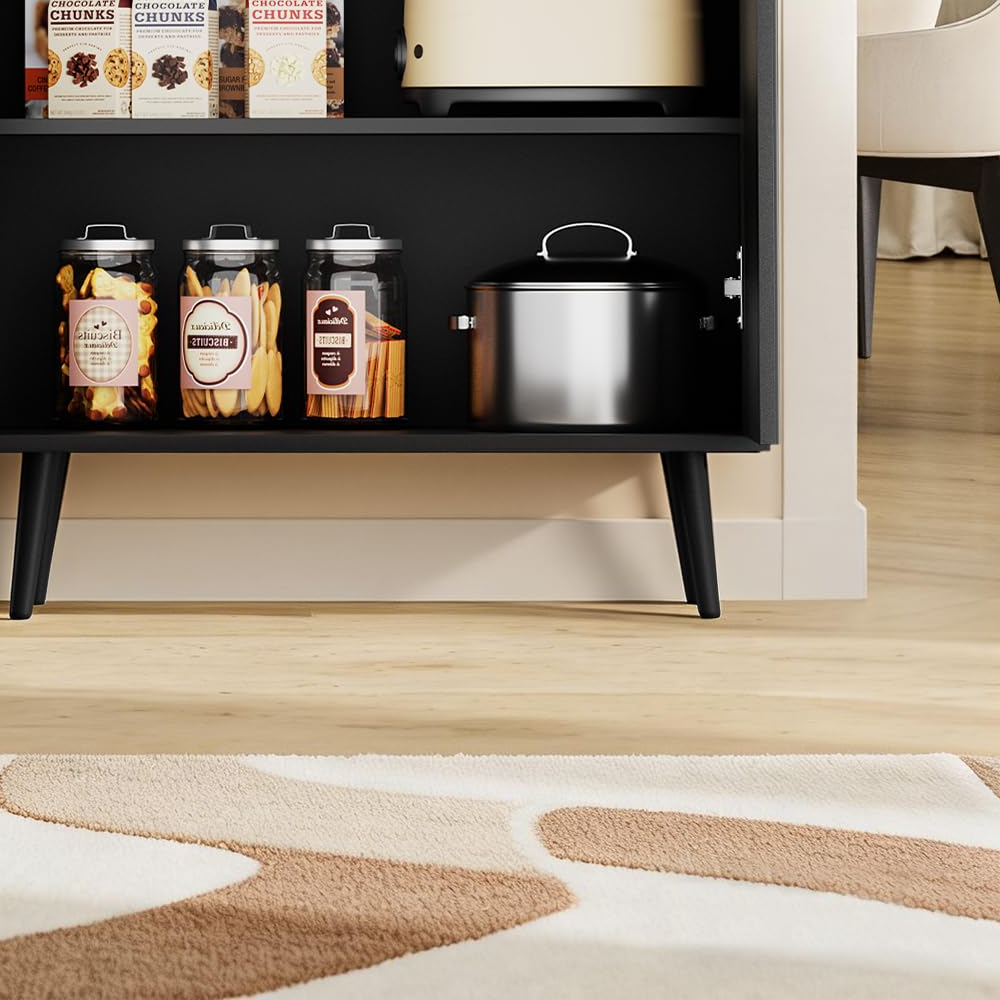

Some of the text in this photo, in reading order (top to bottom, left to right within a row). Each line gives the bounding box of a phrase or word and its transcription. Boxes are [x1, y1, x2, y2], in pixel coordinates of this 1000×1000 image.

[51, 0, 115, 8] CHOCOLATE
[135, 2, 206, 10] CHOCOLATE
[50, 9, 115, 20] CHUNKS
[134, 12, 205, 22] CHUNKS
[252, 9, 324, 20] CHUNKS
